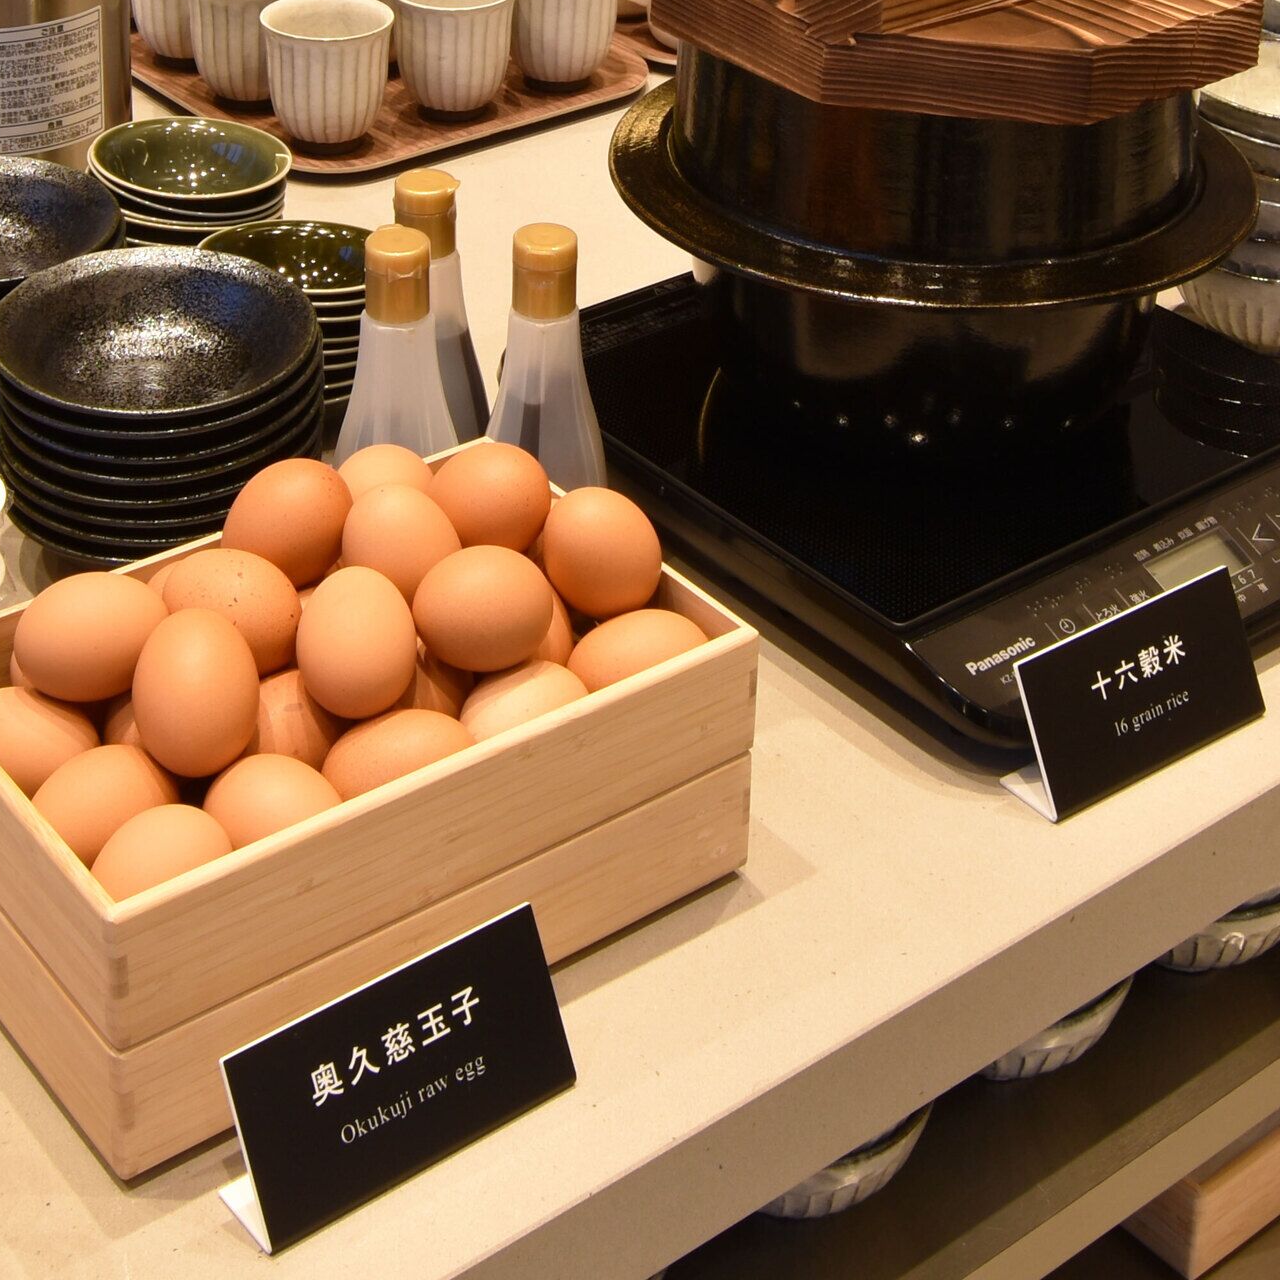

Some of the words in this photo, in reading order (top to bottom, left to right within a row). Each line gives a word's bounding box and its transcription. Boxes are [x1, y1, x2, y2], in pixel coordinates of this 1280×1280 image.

[1237, 574, 1247, 585] 6
[1246, 569, 1256, 579] 7
[964, 635, 1037, 677] Panasonic
[1091, 634, 1186, 701] 十六穀米
[1114, 717, 1129, 737] 16
[1131, 703, 1164, 732] grain
[1166, 690, 1190, 711] rice
[310, 985, 480, 1107] 奥久慈玉子
[340, 1090, 414, 1144] Okukuji
[418, 1074, 449, 1104] raw
[454, 1055, 487, 1082] egg
